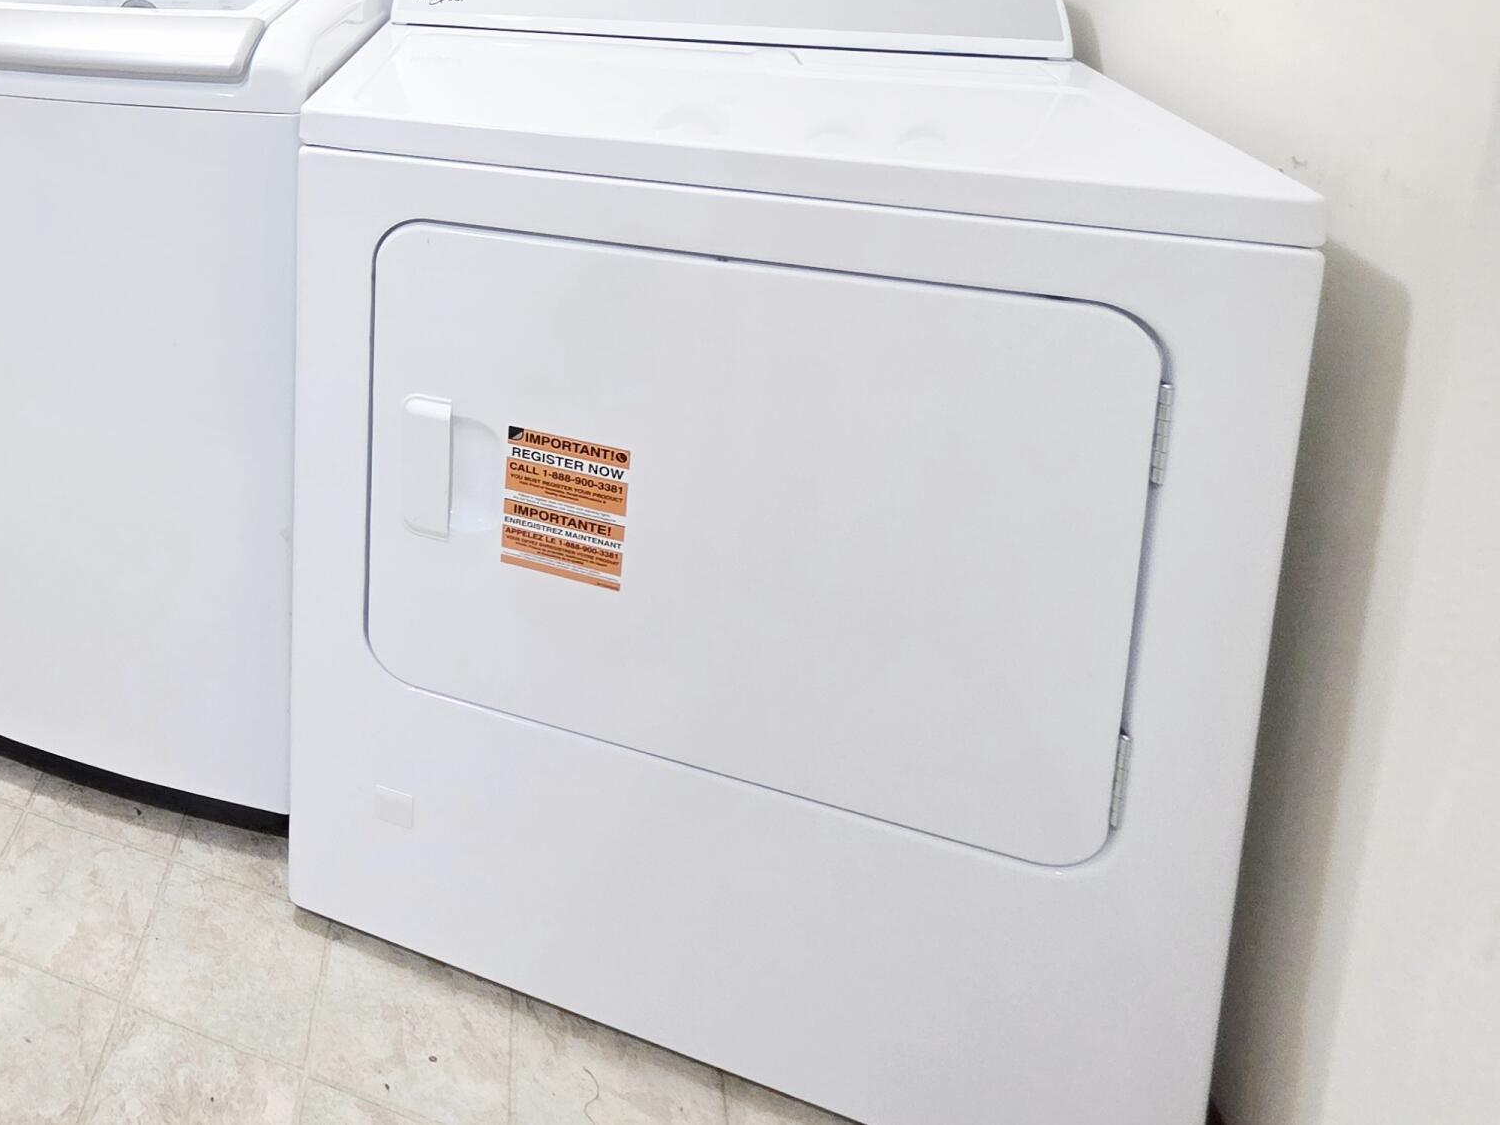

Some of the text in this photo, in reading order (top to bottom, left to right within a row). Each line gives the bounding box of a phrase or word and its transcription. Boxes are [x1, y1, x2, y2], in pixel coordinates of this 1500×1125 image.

[511, 446, 625, 480] REGISTER NOW
[525, 431, 615, 462] IMPORTANT!
[509, 461, 540, 476] CALL
[542, 468, 624, 495] 1-888-900-3381
[510, 473, 523, 481] YOU
[542, 479, 573, 493] REGISTER
[592, 491, 624, 504] PRODUCT
[504, 515, 622, 550] ENREGISTREZ MAINTENANT
[505, 526, 544, 542] APPELEZ
[545, 535, 556, 544] LE
[513, 503, 612, 537] IMPORTANTE!
